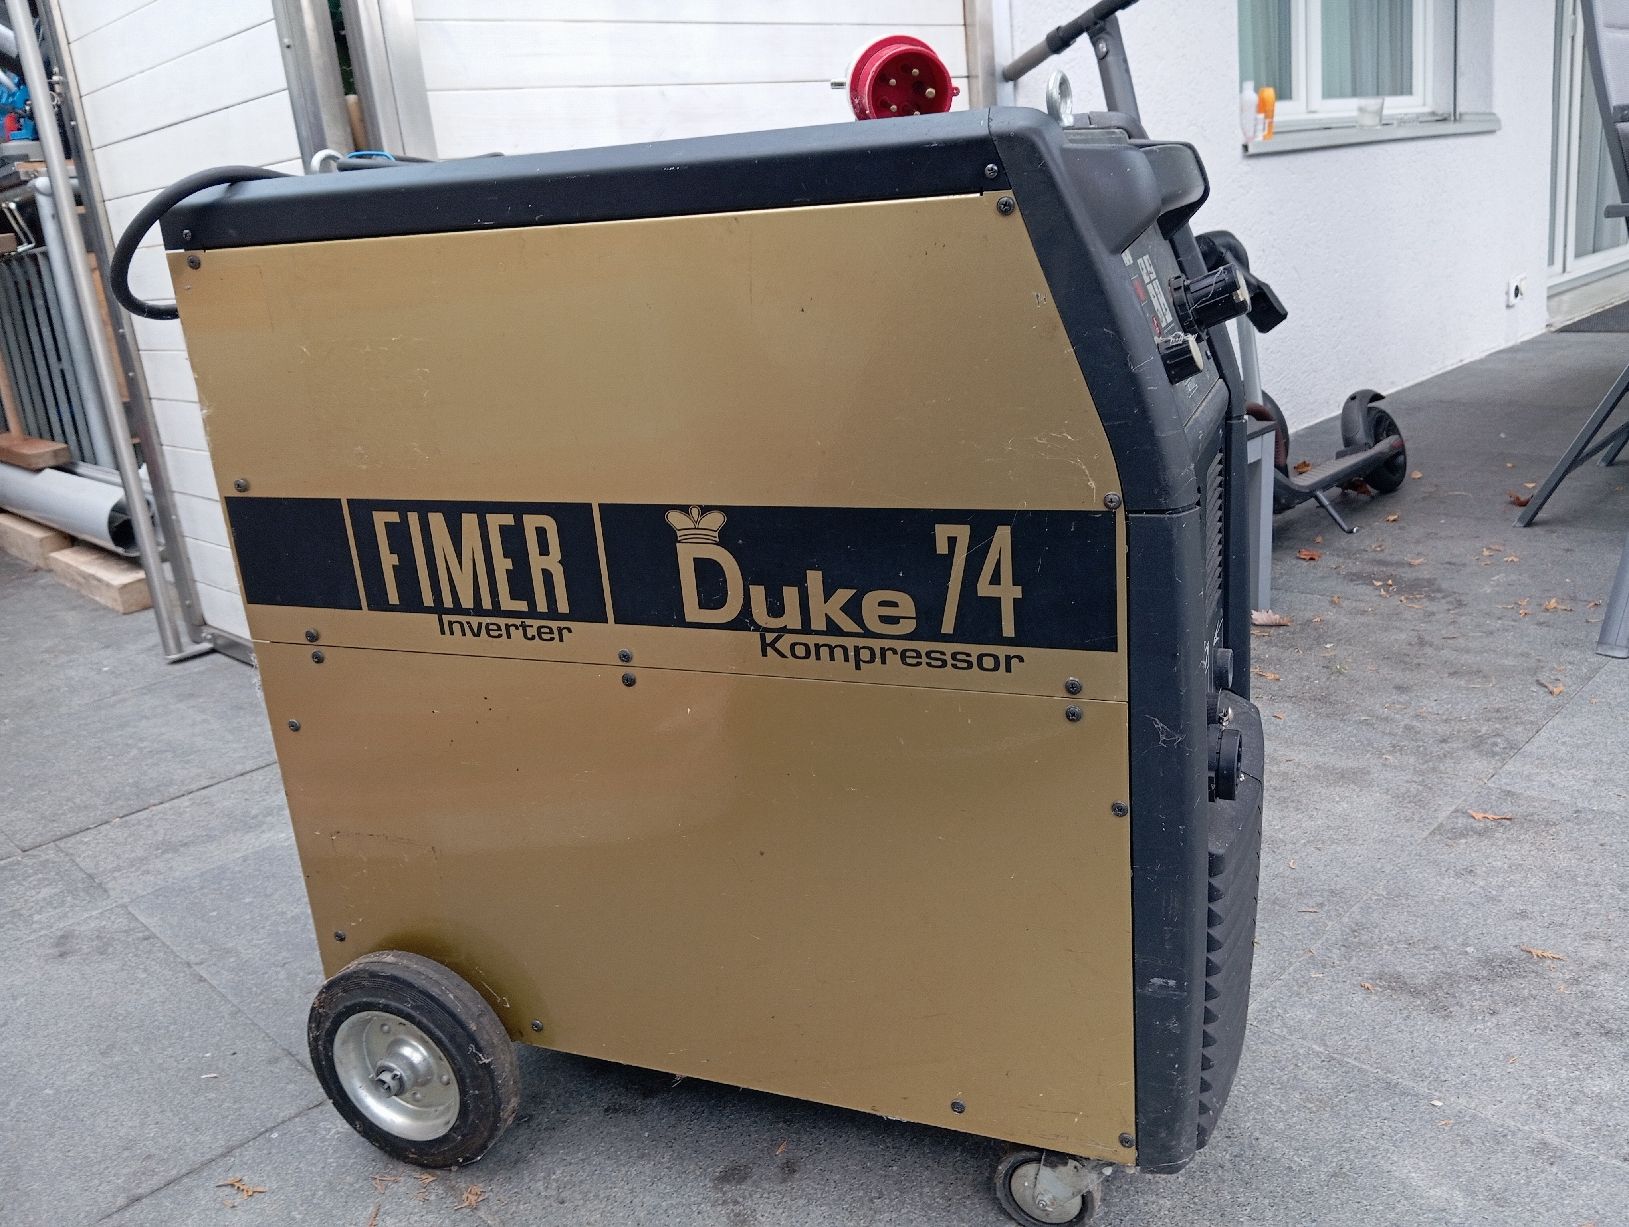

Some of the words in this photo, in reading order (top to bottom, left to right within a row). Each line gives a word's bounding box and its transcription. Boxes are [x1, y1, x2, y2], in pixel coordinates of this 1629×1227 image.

[371, 511, 570, 614] FIMER
[676, 542, 917, 636] Duke
[934, 524, 1023, 638] 74
[437, 613, 573, 643] Inverter
[759, 632, 1025, 673] Kompressor
